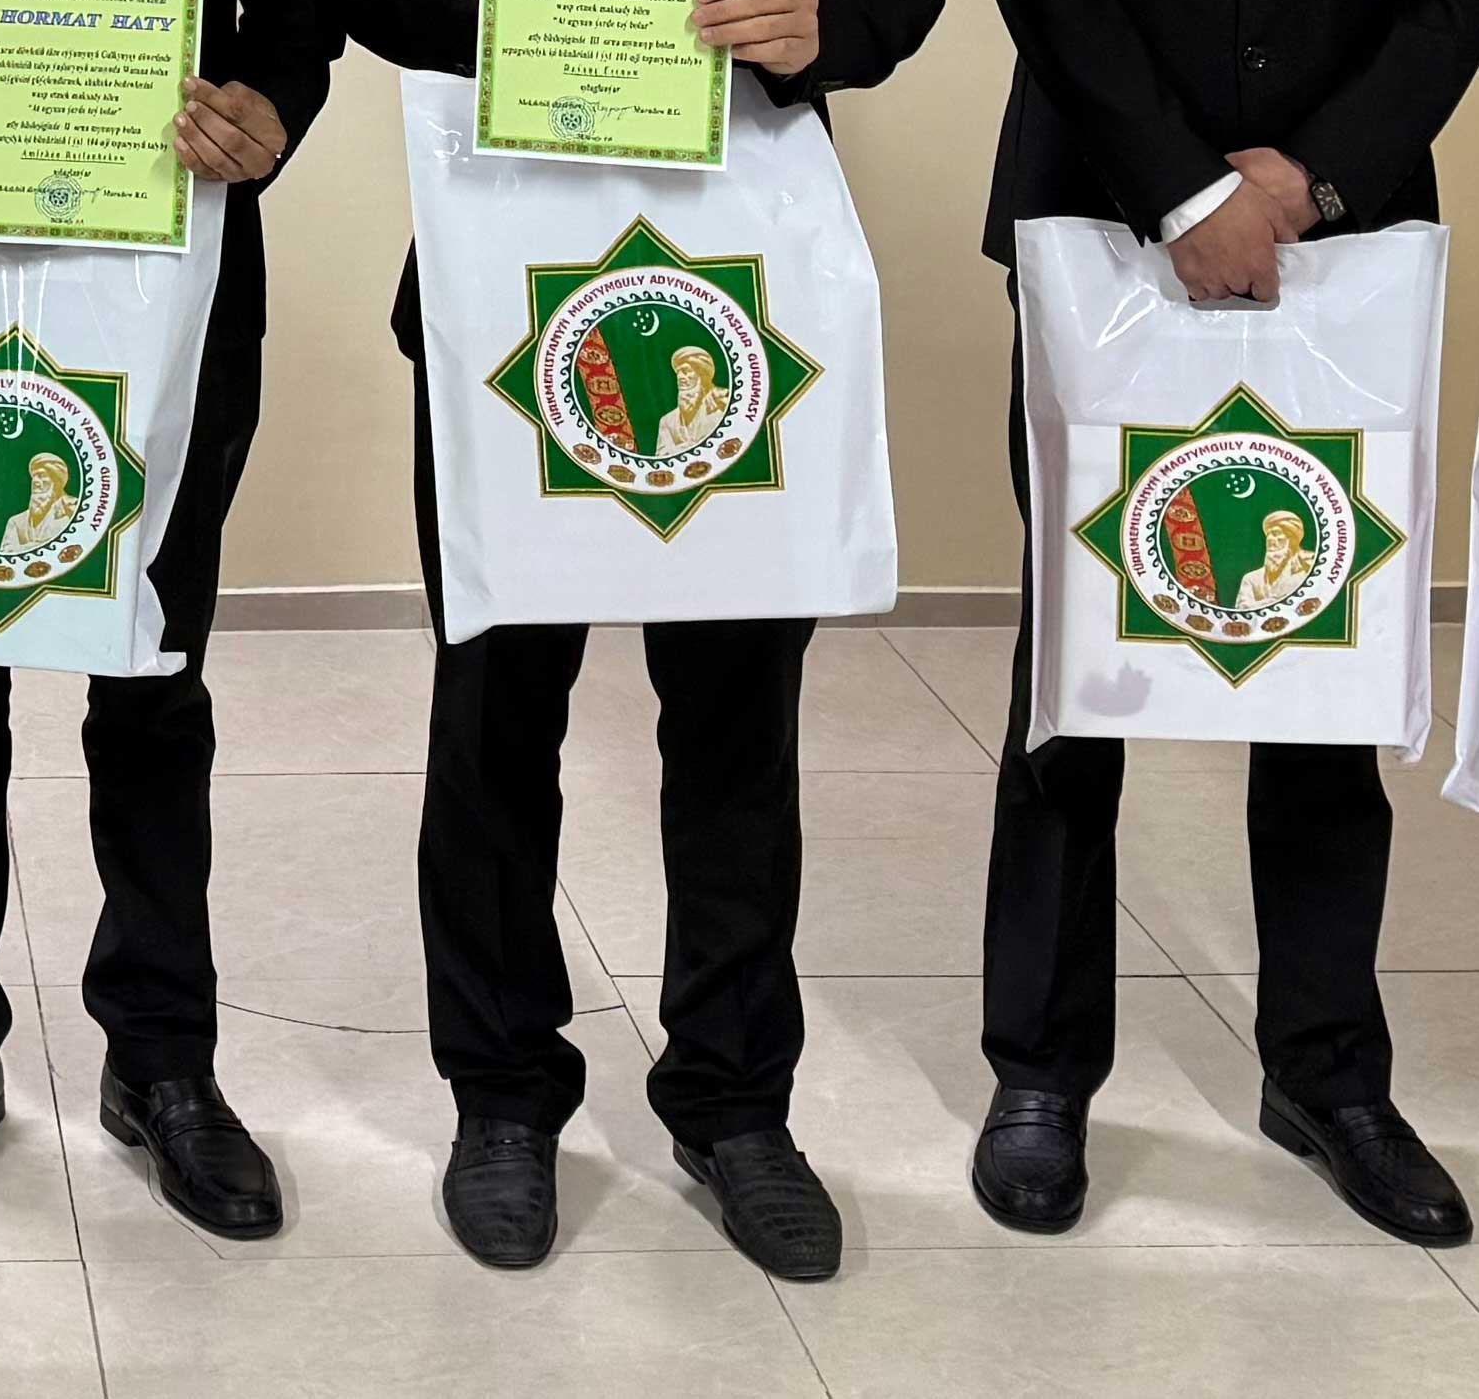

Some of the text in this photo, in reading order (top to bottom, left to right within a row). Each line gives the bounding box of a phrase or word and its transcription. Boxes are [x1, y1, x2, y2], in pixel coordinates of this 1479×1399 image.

[0, 9, 177, 32] HORMAT HATY
[567, 275, 644, 317] MAGTYMGULY
[744, 352, 760, 422] GURAMASY
[88, 466, 110, 532] GURAMASY
[1158, 440, 1243, 476] MAGTYMGULY
[1325, 519, 1347, 584] GURAMASY
